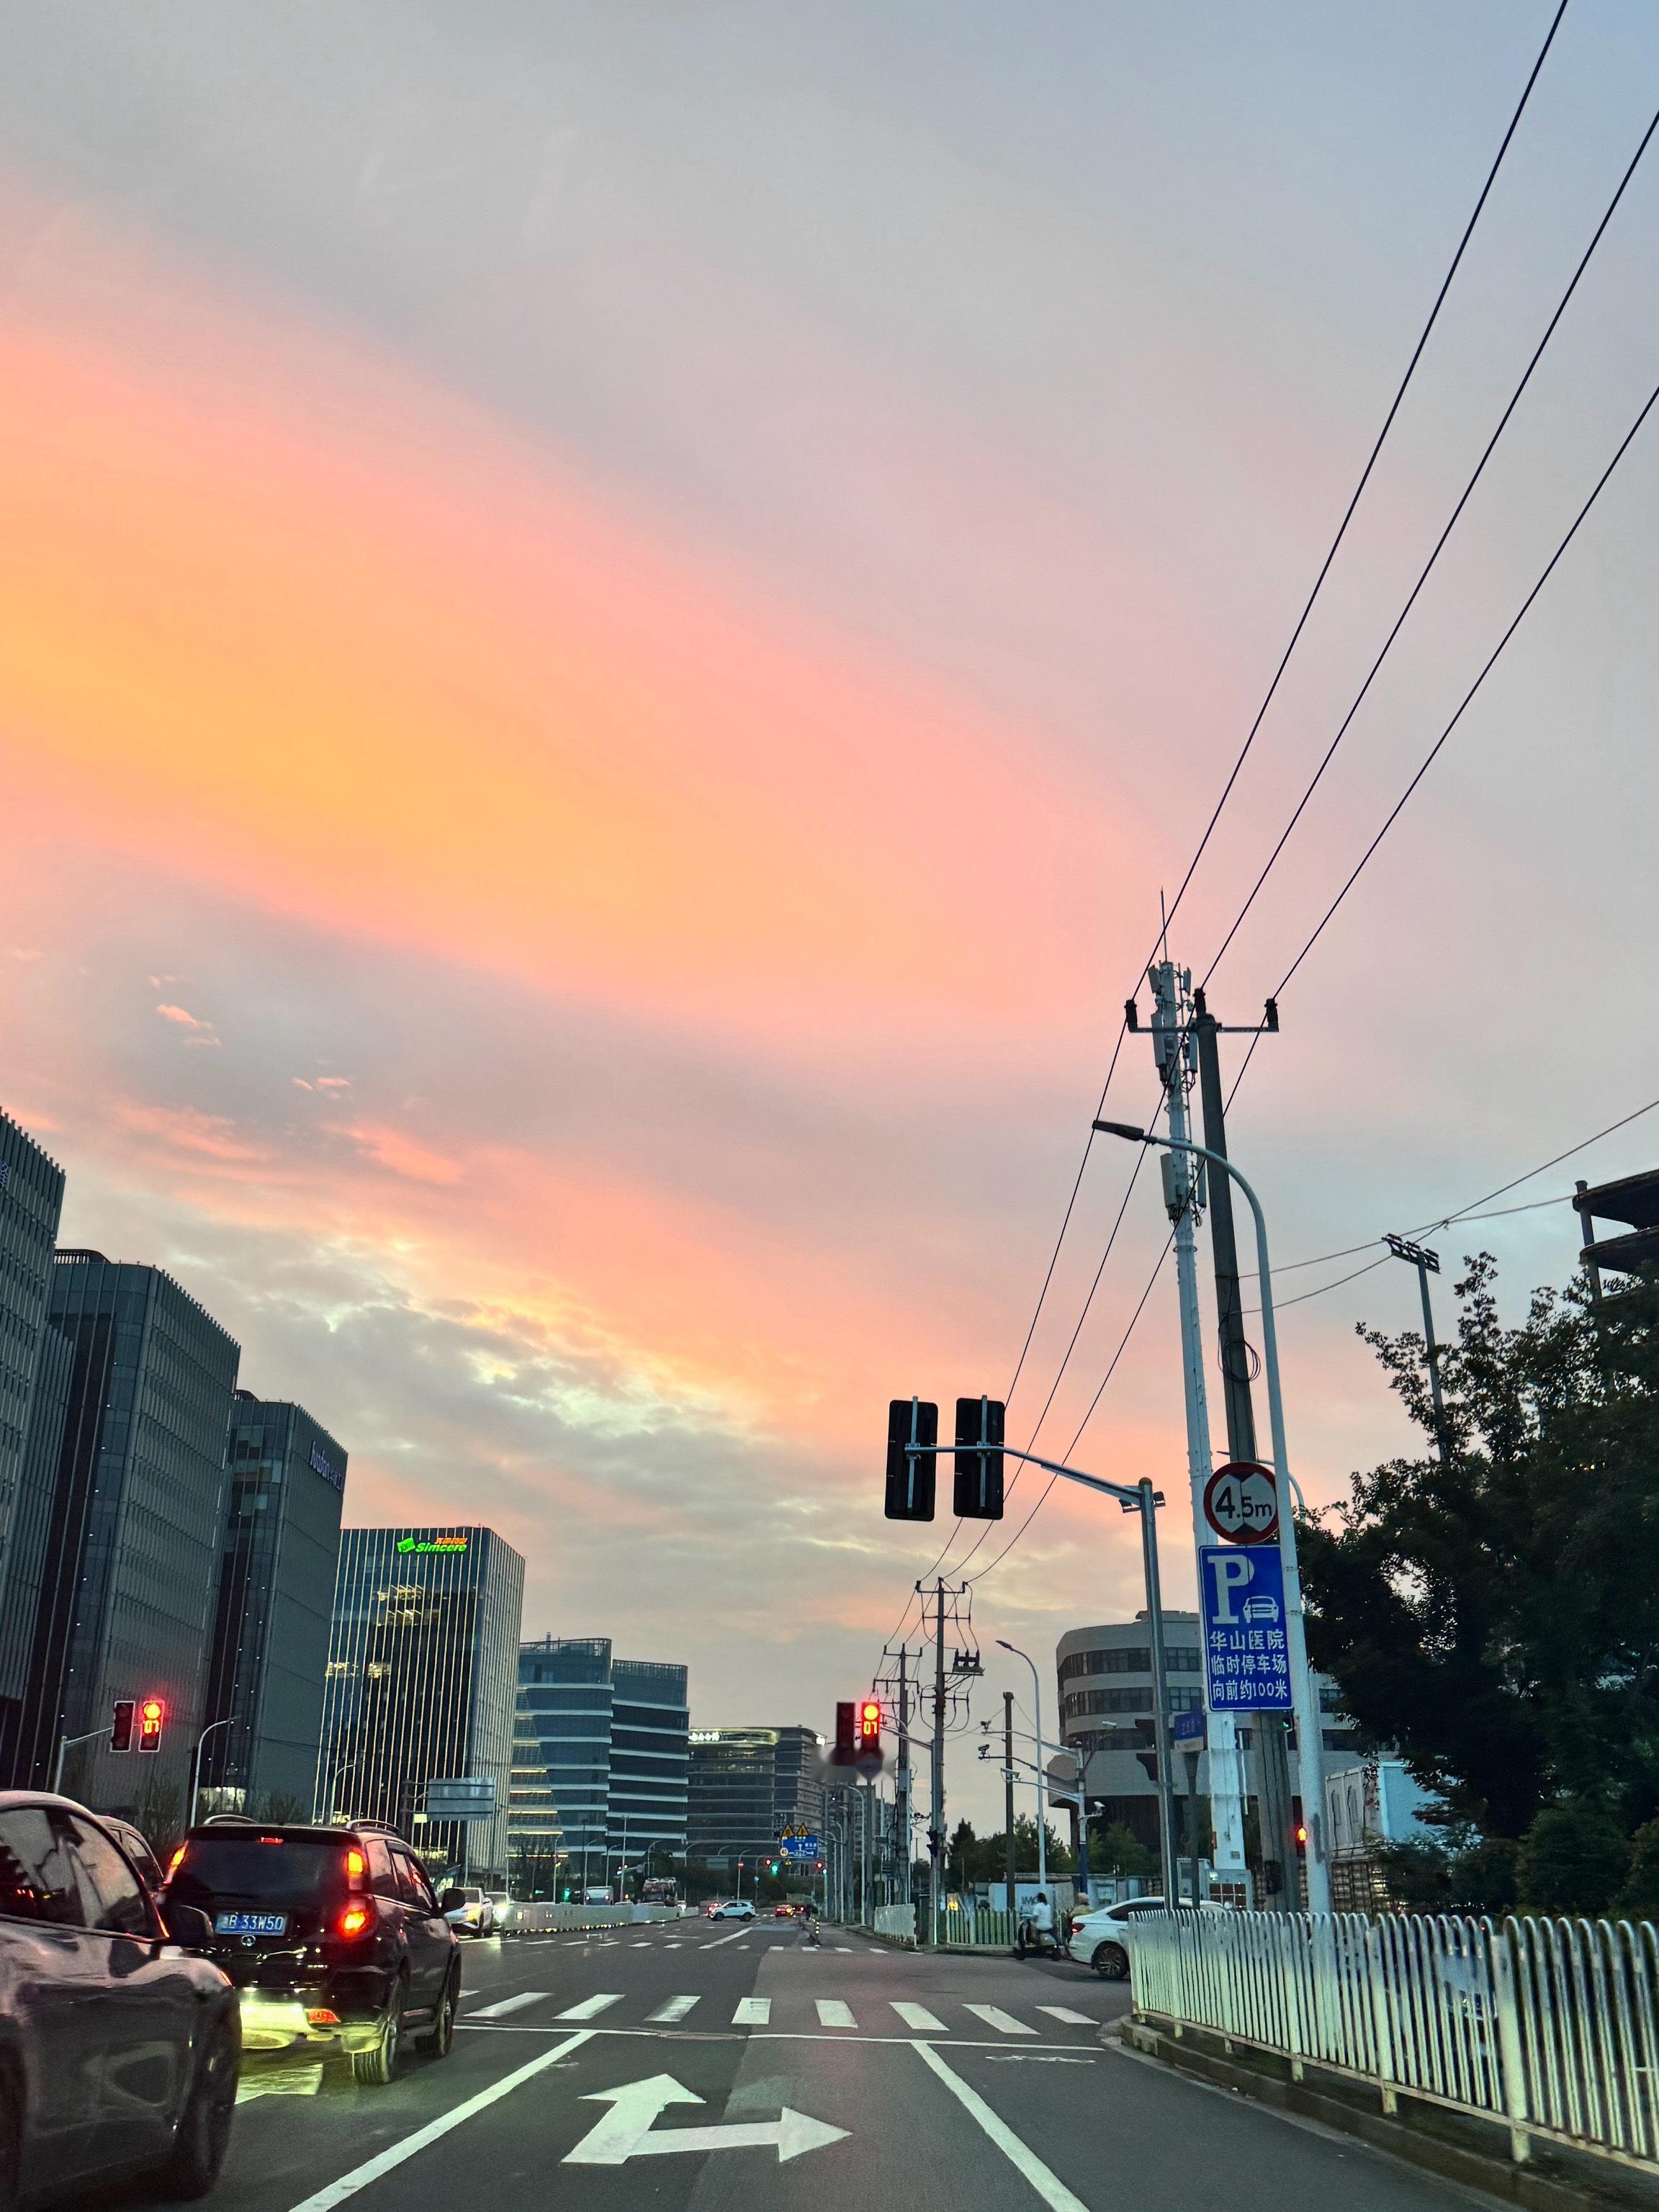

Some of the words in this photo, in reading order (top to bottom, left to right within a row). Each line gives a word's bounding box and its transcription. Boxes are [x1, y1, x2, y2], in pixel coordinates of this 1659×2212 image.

[1215, 1485, 1272, 1519] 4.5m
[1207, 1554, 1255, 1624] P
[1210, 1629, 1285, 1652] 华山医院
[1211, 1654, 1287, 1676] 临时停车场
[1213, 1678, 1288, 1701] 向前约100米
[863, 1721, 878, 1735] 07
